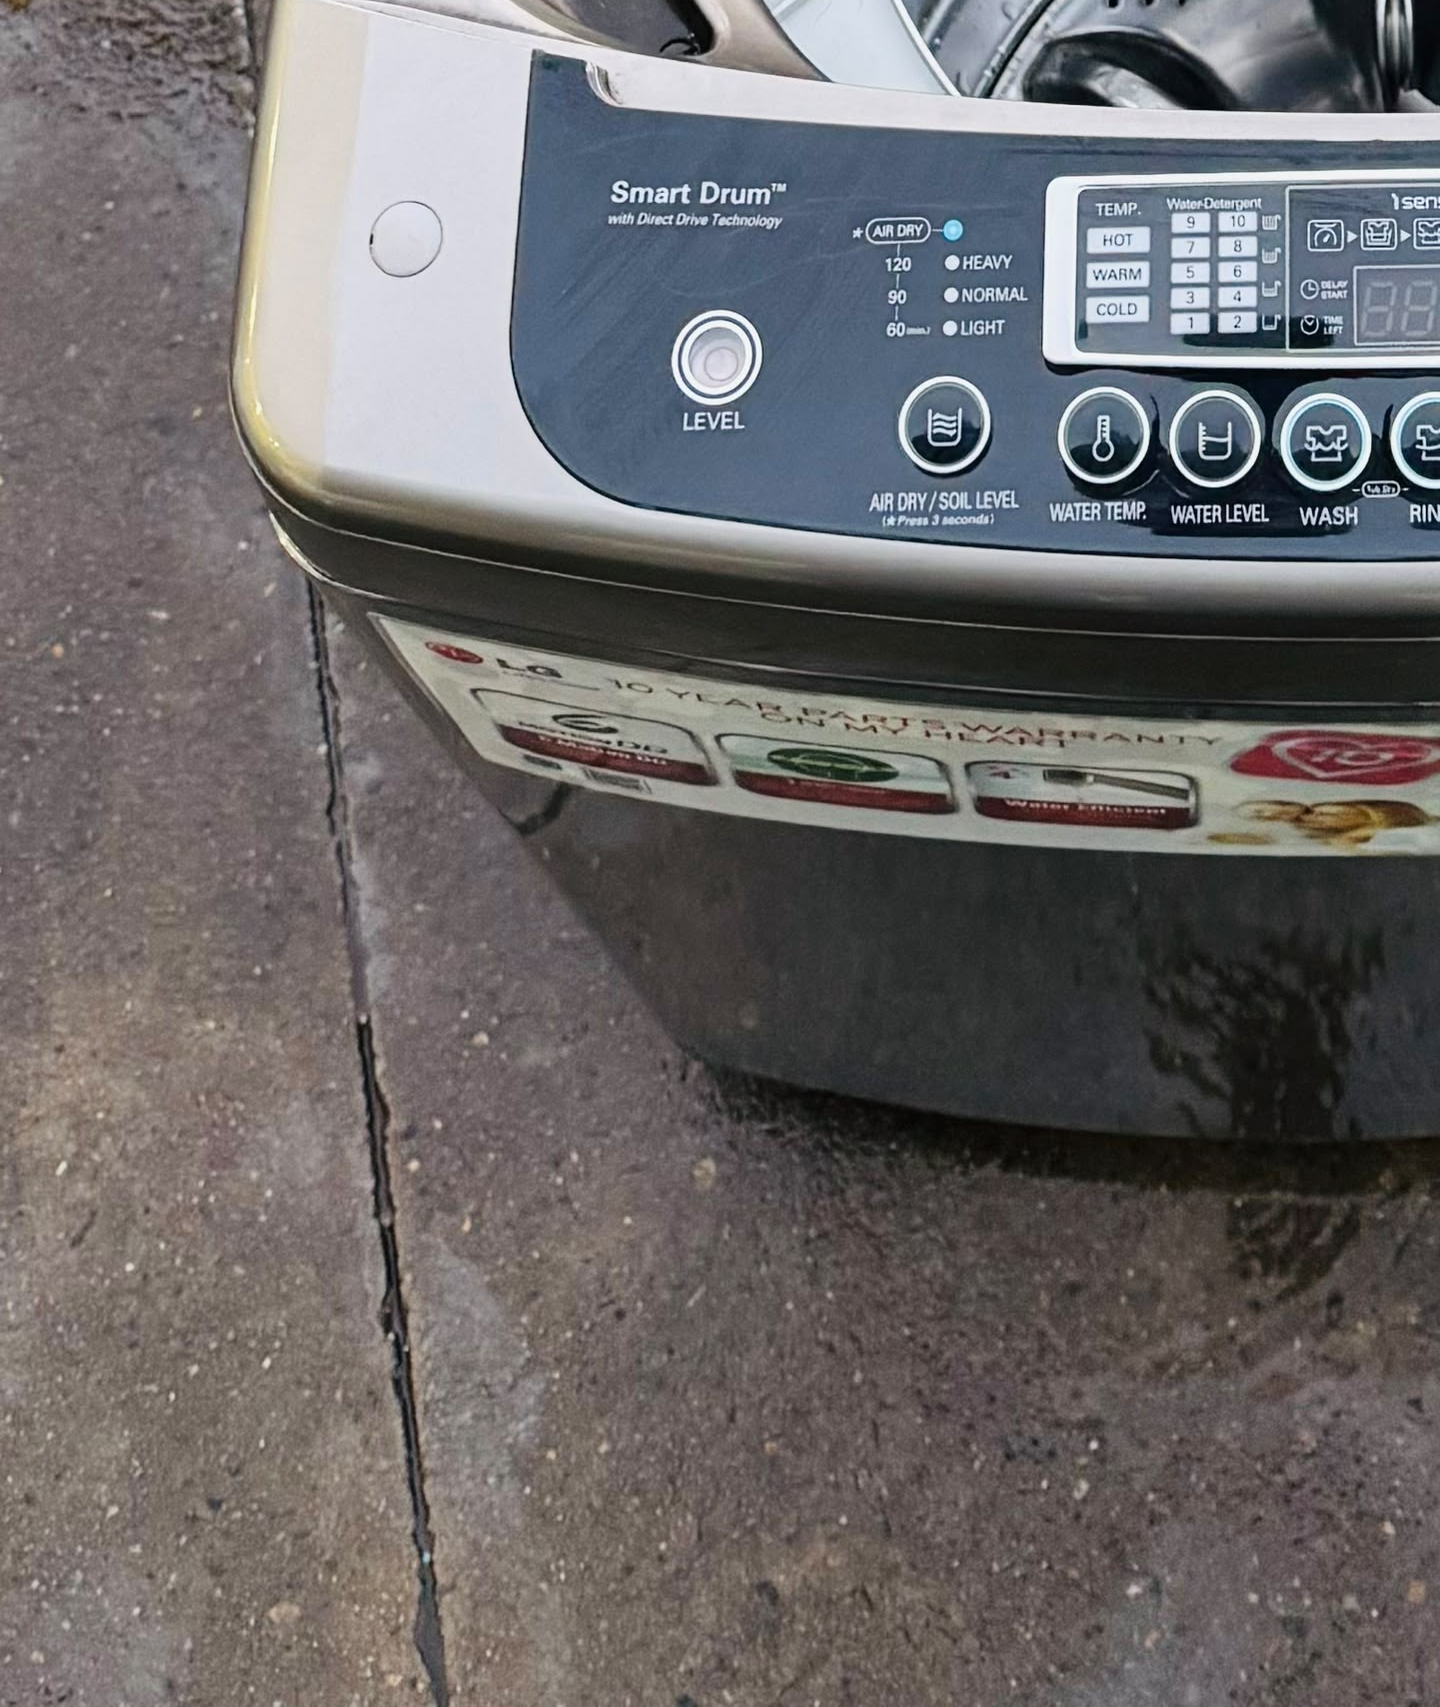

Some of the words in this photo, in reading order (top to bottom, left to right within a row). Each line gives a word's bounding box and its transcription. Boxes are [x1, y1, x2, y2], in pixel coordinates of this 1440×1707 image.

[610, 179, 692, 204] Smart
[1095, 202, 1142, 217] TEMP.
[607, 212, 635, 225] with
[636, 212, 674, 226] Direct
[675, 212, 709, 227] Drive
[711, 213, 784, 230] Technology
[1186, 216, 1196, 229] 9
[1231, 214, 1247, 228] 10
[872, 224, 894, 238] AIR
[896, 223, 924, 238] DRY
[1102, 233, 1133, 248] HOT
[1186, 240, 1196, 254] 7
[1233, 239, 1243, 253] 8
[884, 256, 912, 272] 120
[962, 254, 1013, 271] HEAVY
[1092, 267, 1142, 282] WARM
[1185, 265, 1195, 279] 5
[1233, 264, 1242, 278] 6
[1320, 280, 1349, 290] DELAY
[887, 289, 908, 305] 90
[961, 286, 1029, 303] NORMAL
[1185, 290, 1195, 305] 3
[1232, 289, 1242, 303] 4
[1096, 302, 1138, 317] COLD
[960, 319, 1006, 336] LIGHT
[1187, 316, 1195, 330] 1
[1233, 315, 1242, 329] 2
[1323, 315, 1344, 326] TIME
[1323, 325, 1344, 335] LEFT
[682, 410, 746, 432] LEVEL
[868, 491, 894, 513] AIR
[897, 491, 928, 513] DRY
[938, 490, 973, 511] SOIL
[975, 489, 1020, 510] LEVEL
[1049, 501, 1102, 523] WATER
[1103, 500, 1147, 522] TEMP.
[1170, 504, 1223, 525] WATER
[1225, 503, 1270, 524] LEVEL
[1300, 506, 1359, 527] WASH
[496, 657, 563, 679] LG
[762, 710, 825, 728] ON
[844, 718, 911, 735] MY
[801, 705, 946, 730] PARTS
[960, 721, 1223, 745] WARRANTY
